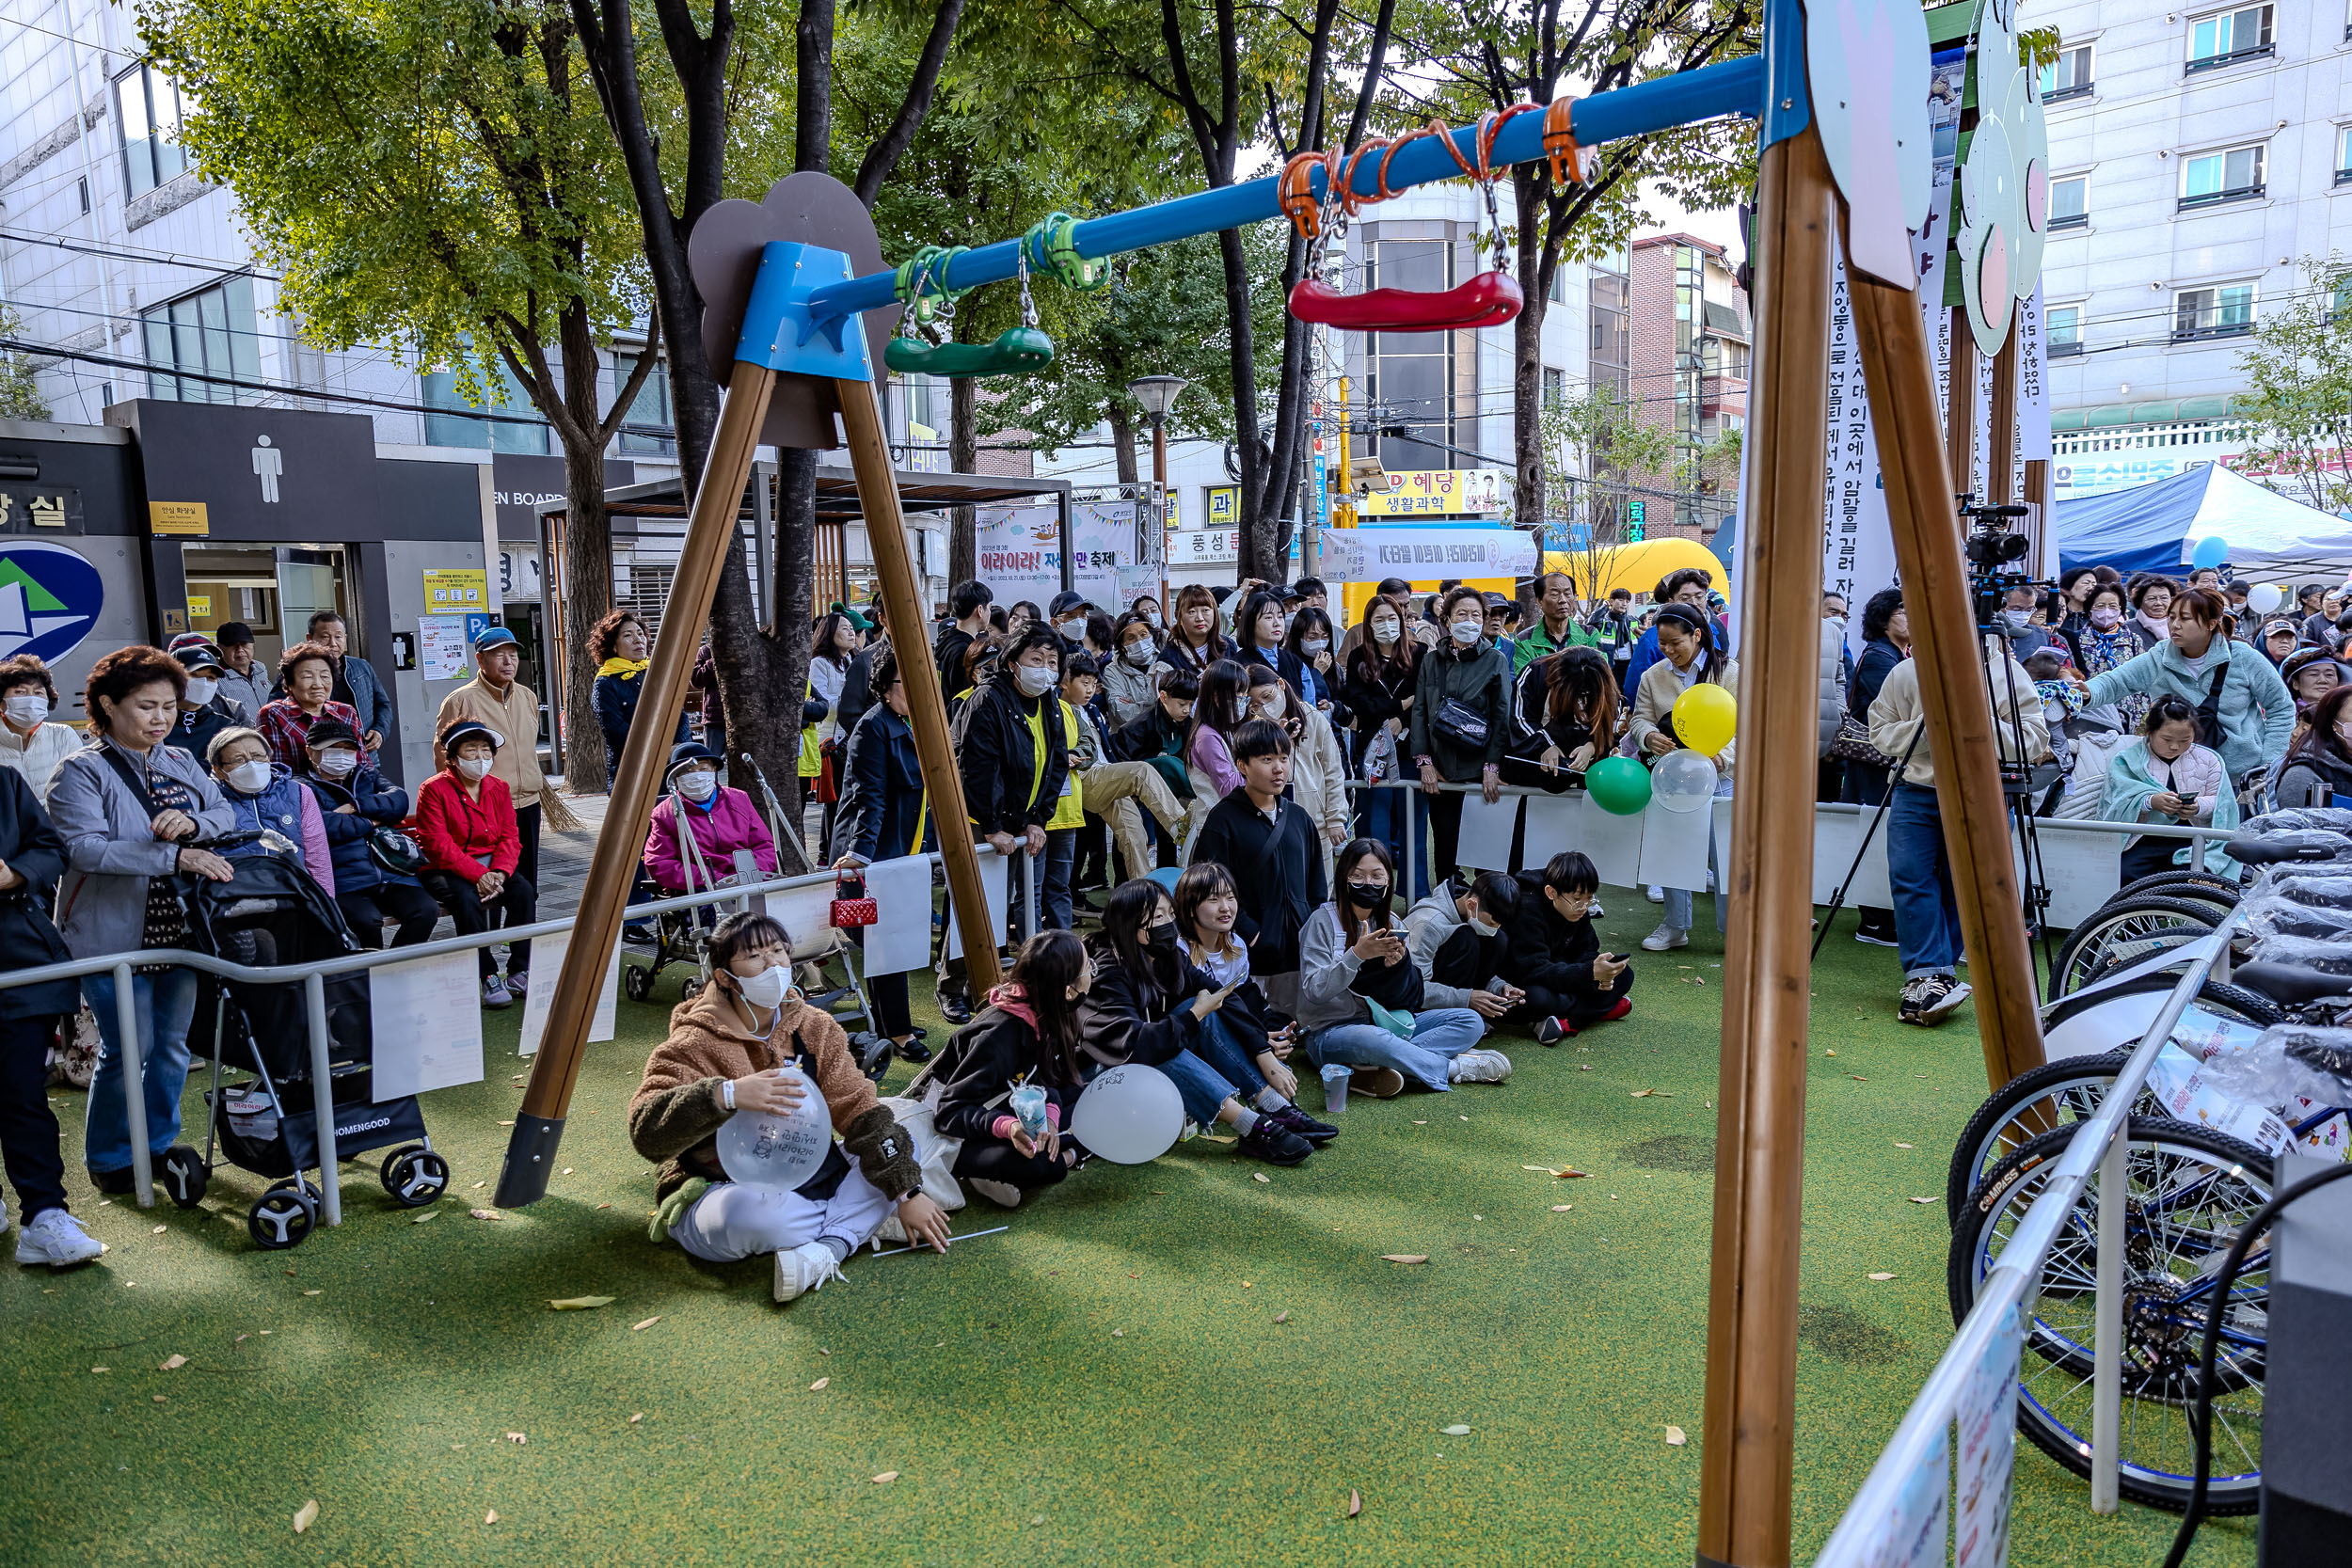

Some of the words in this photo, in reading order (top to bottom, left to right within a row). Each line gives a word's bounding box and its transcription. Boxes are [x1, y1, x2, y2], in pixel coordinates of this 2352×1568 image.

[1844, 405, 1867, 475] 이곳에서
[1412, 471, 1456, 495] 혜당
[176, 506, 196, 515] 화장실
[1386, 496, 1445, 513] 생활과학
[1840, 480, 1863, 533] 암말을
[980, 551, 1041, 572] 이랴이랴!
[1044, 551, 1088, 569] 자신만
[1090, 550, 1116, 568] 축제
[1837, 537, 1857, 572] 길러
[1979, 1167, 2020, 1212] COMPASS
